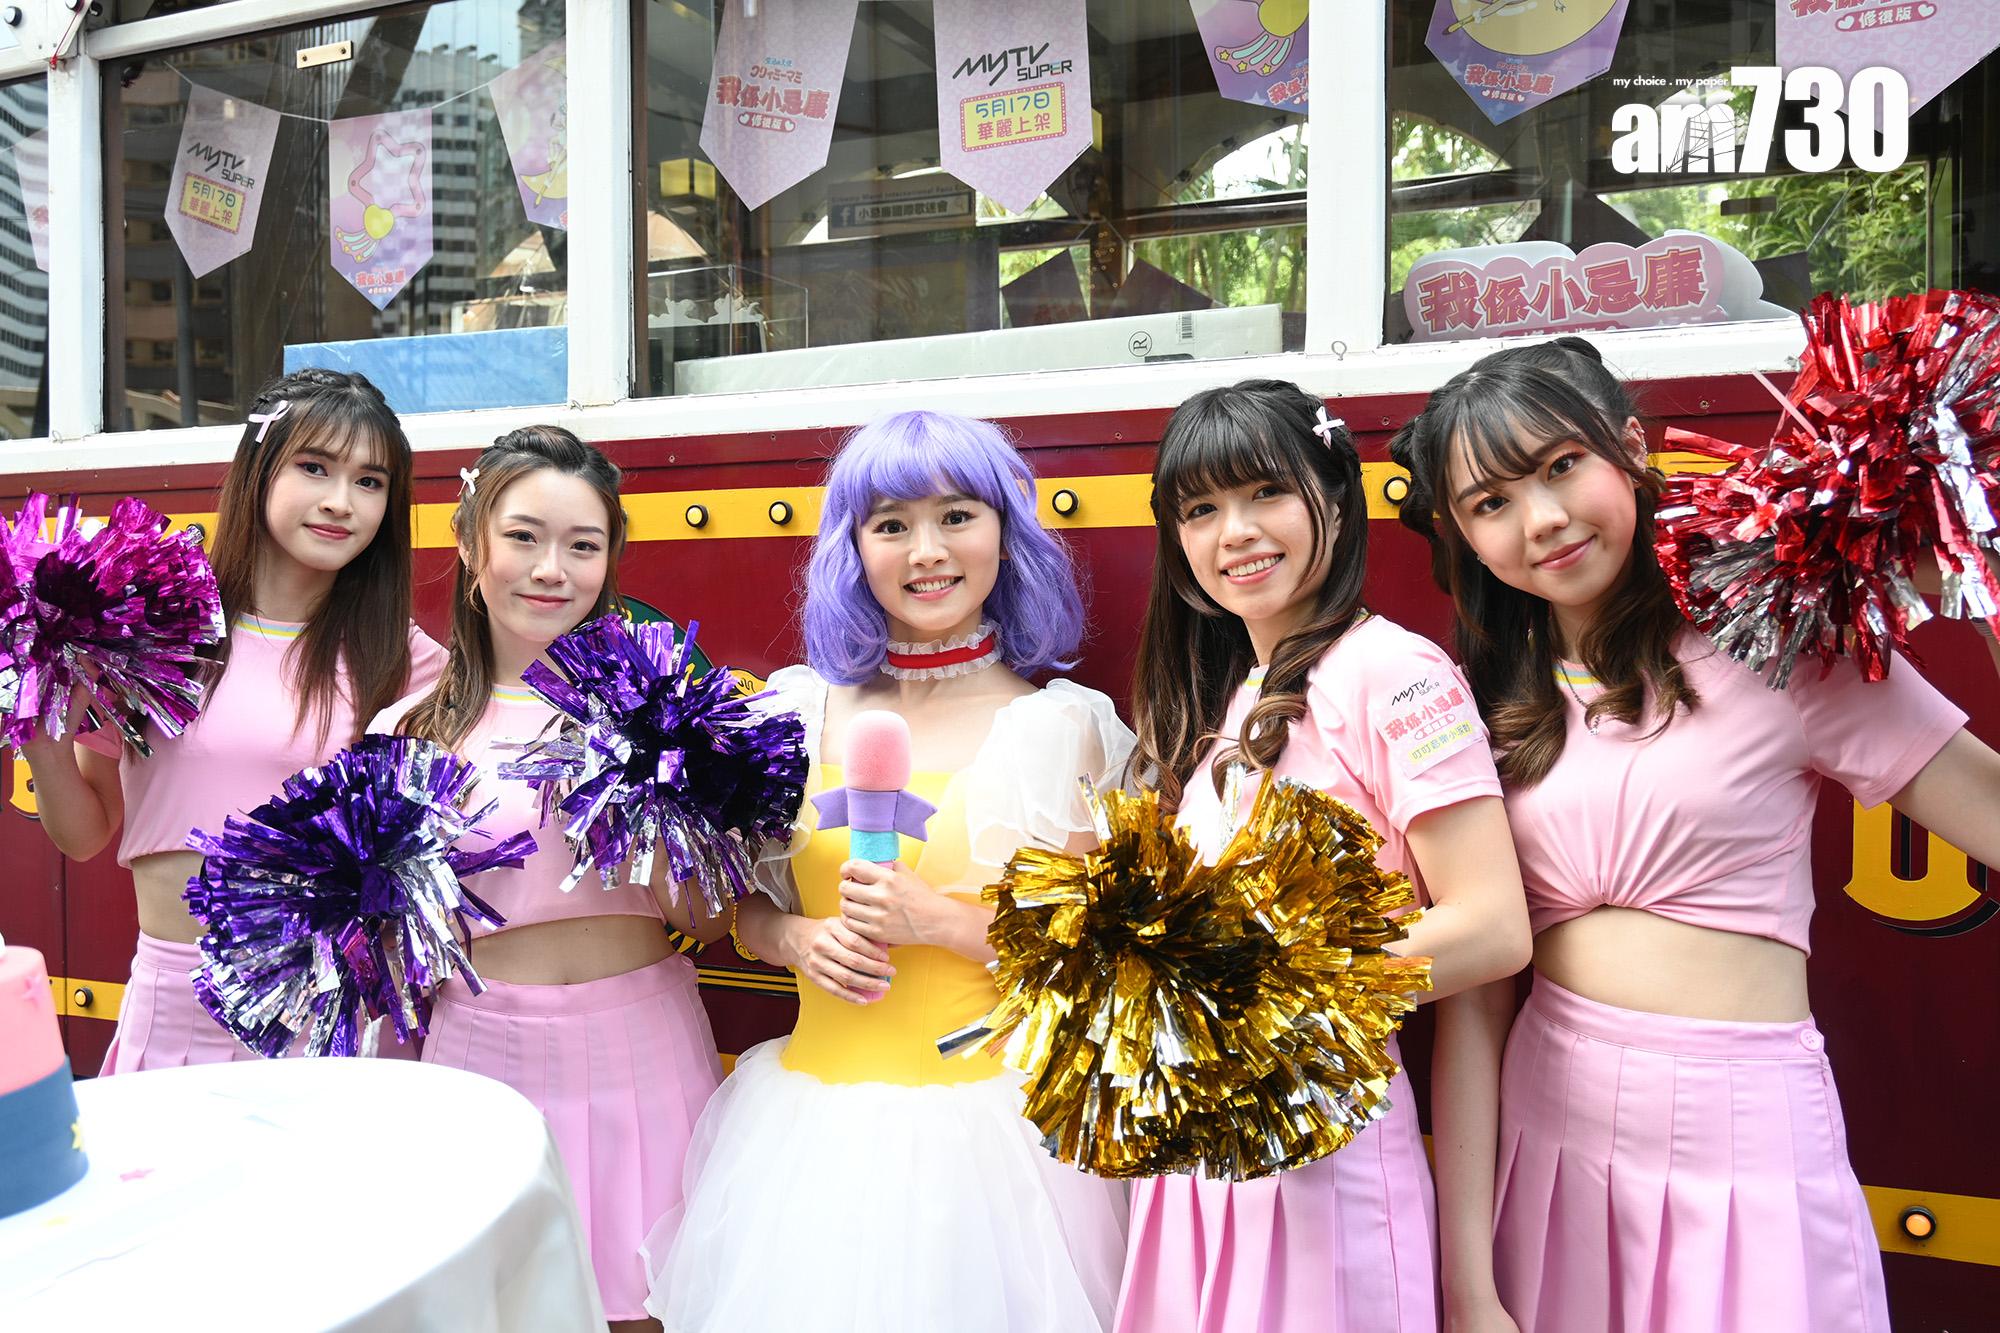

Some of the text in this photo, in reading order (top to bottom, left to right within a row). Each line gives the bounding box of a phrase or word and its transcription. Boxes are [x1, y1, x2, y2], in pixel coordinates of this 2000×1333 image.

[1858, 6, 1912, 28] 修復版
[1017, 59, 1073, 82] SUPER
[1465, 64, 1555, 95] 我係小忌廉
[716, 74, 831, 120] 我係小忌廉
[976, 91, 1050, 118] 5月17日
[977, 113, 1051, 140] 華麗上架
[221, 168, 255, 189] SUPER
[192, 181, 236, 208] 5月17日
[1418, 246, 1708, 334] 我係小忌廉
[1385, 687, 1465, 741] 我係小忌廉
